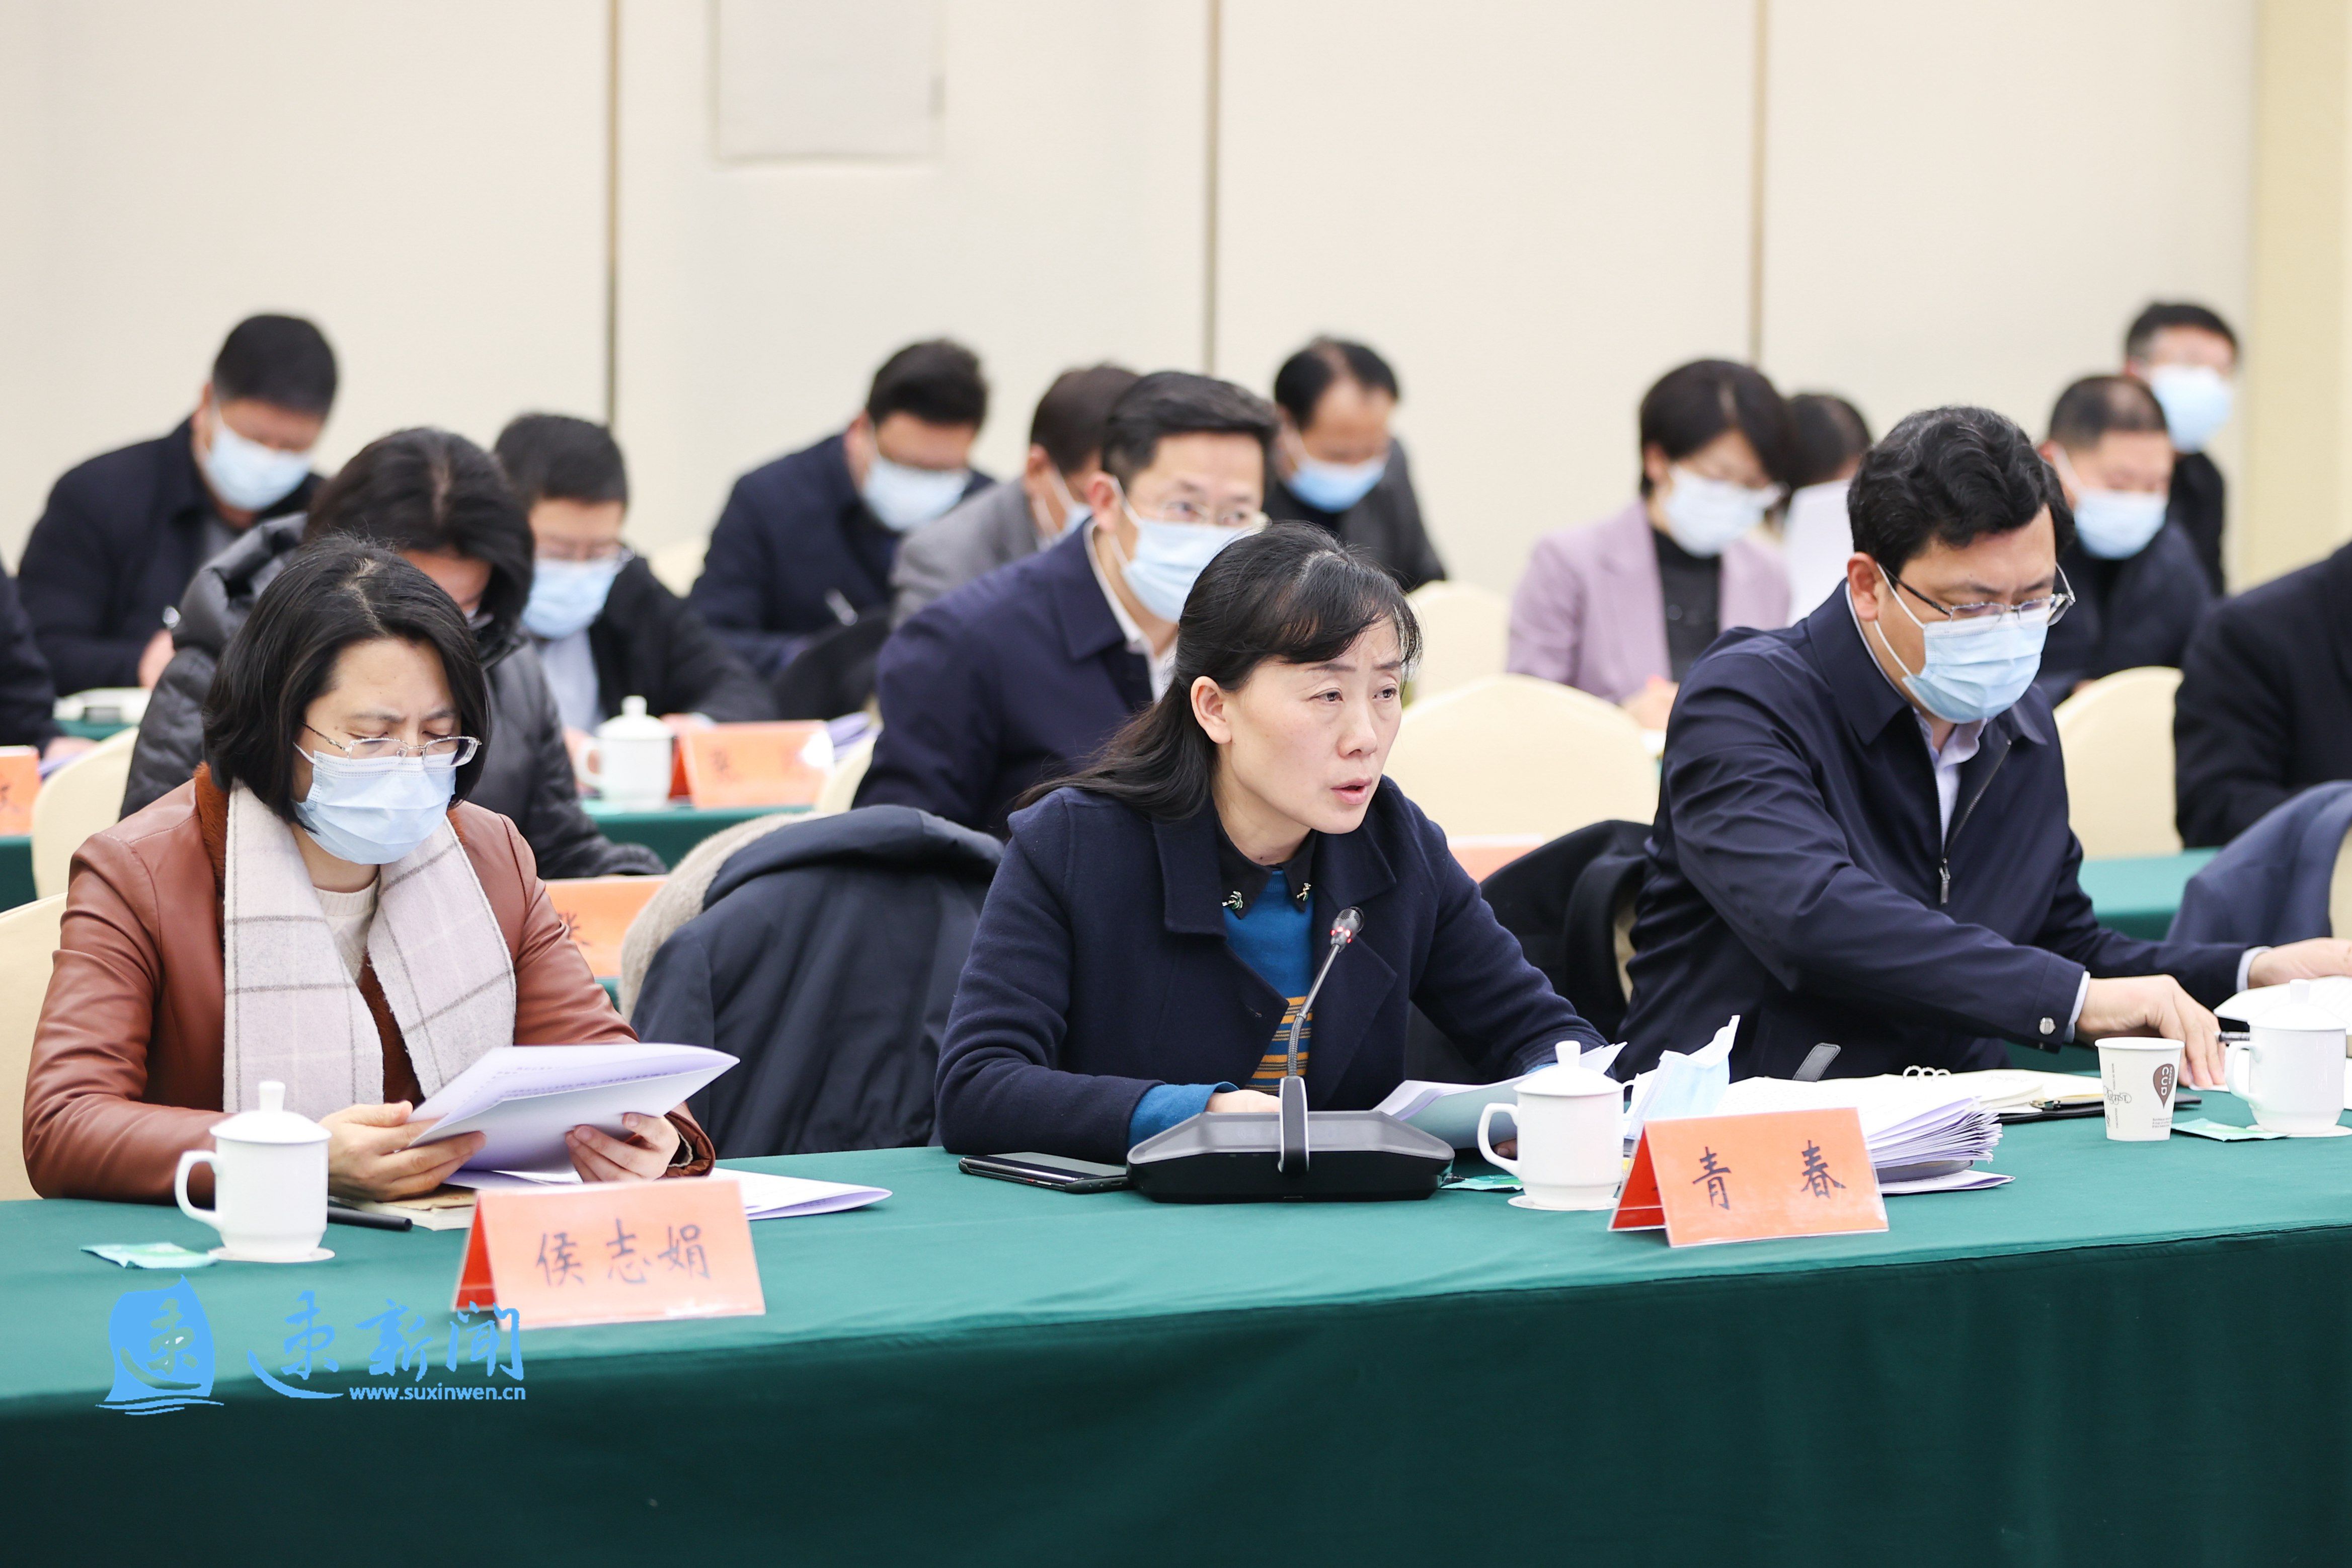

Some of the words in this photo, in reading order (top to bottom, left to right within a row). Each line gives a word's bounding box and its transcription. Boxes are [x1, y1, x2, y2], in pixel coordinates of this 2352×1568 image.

[1692, 1139, 1846, 1210] 青春
[536, 1217, 711, 1288] 侯志娟
